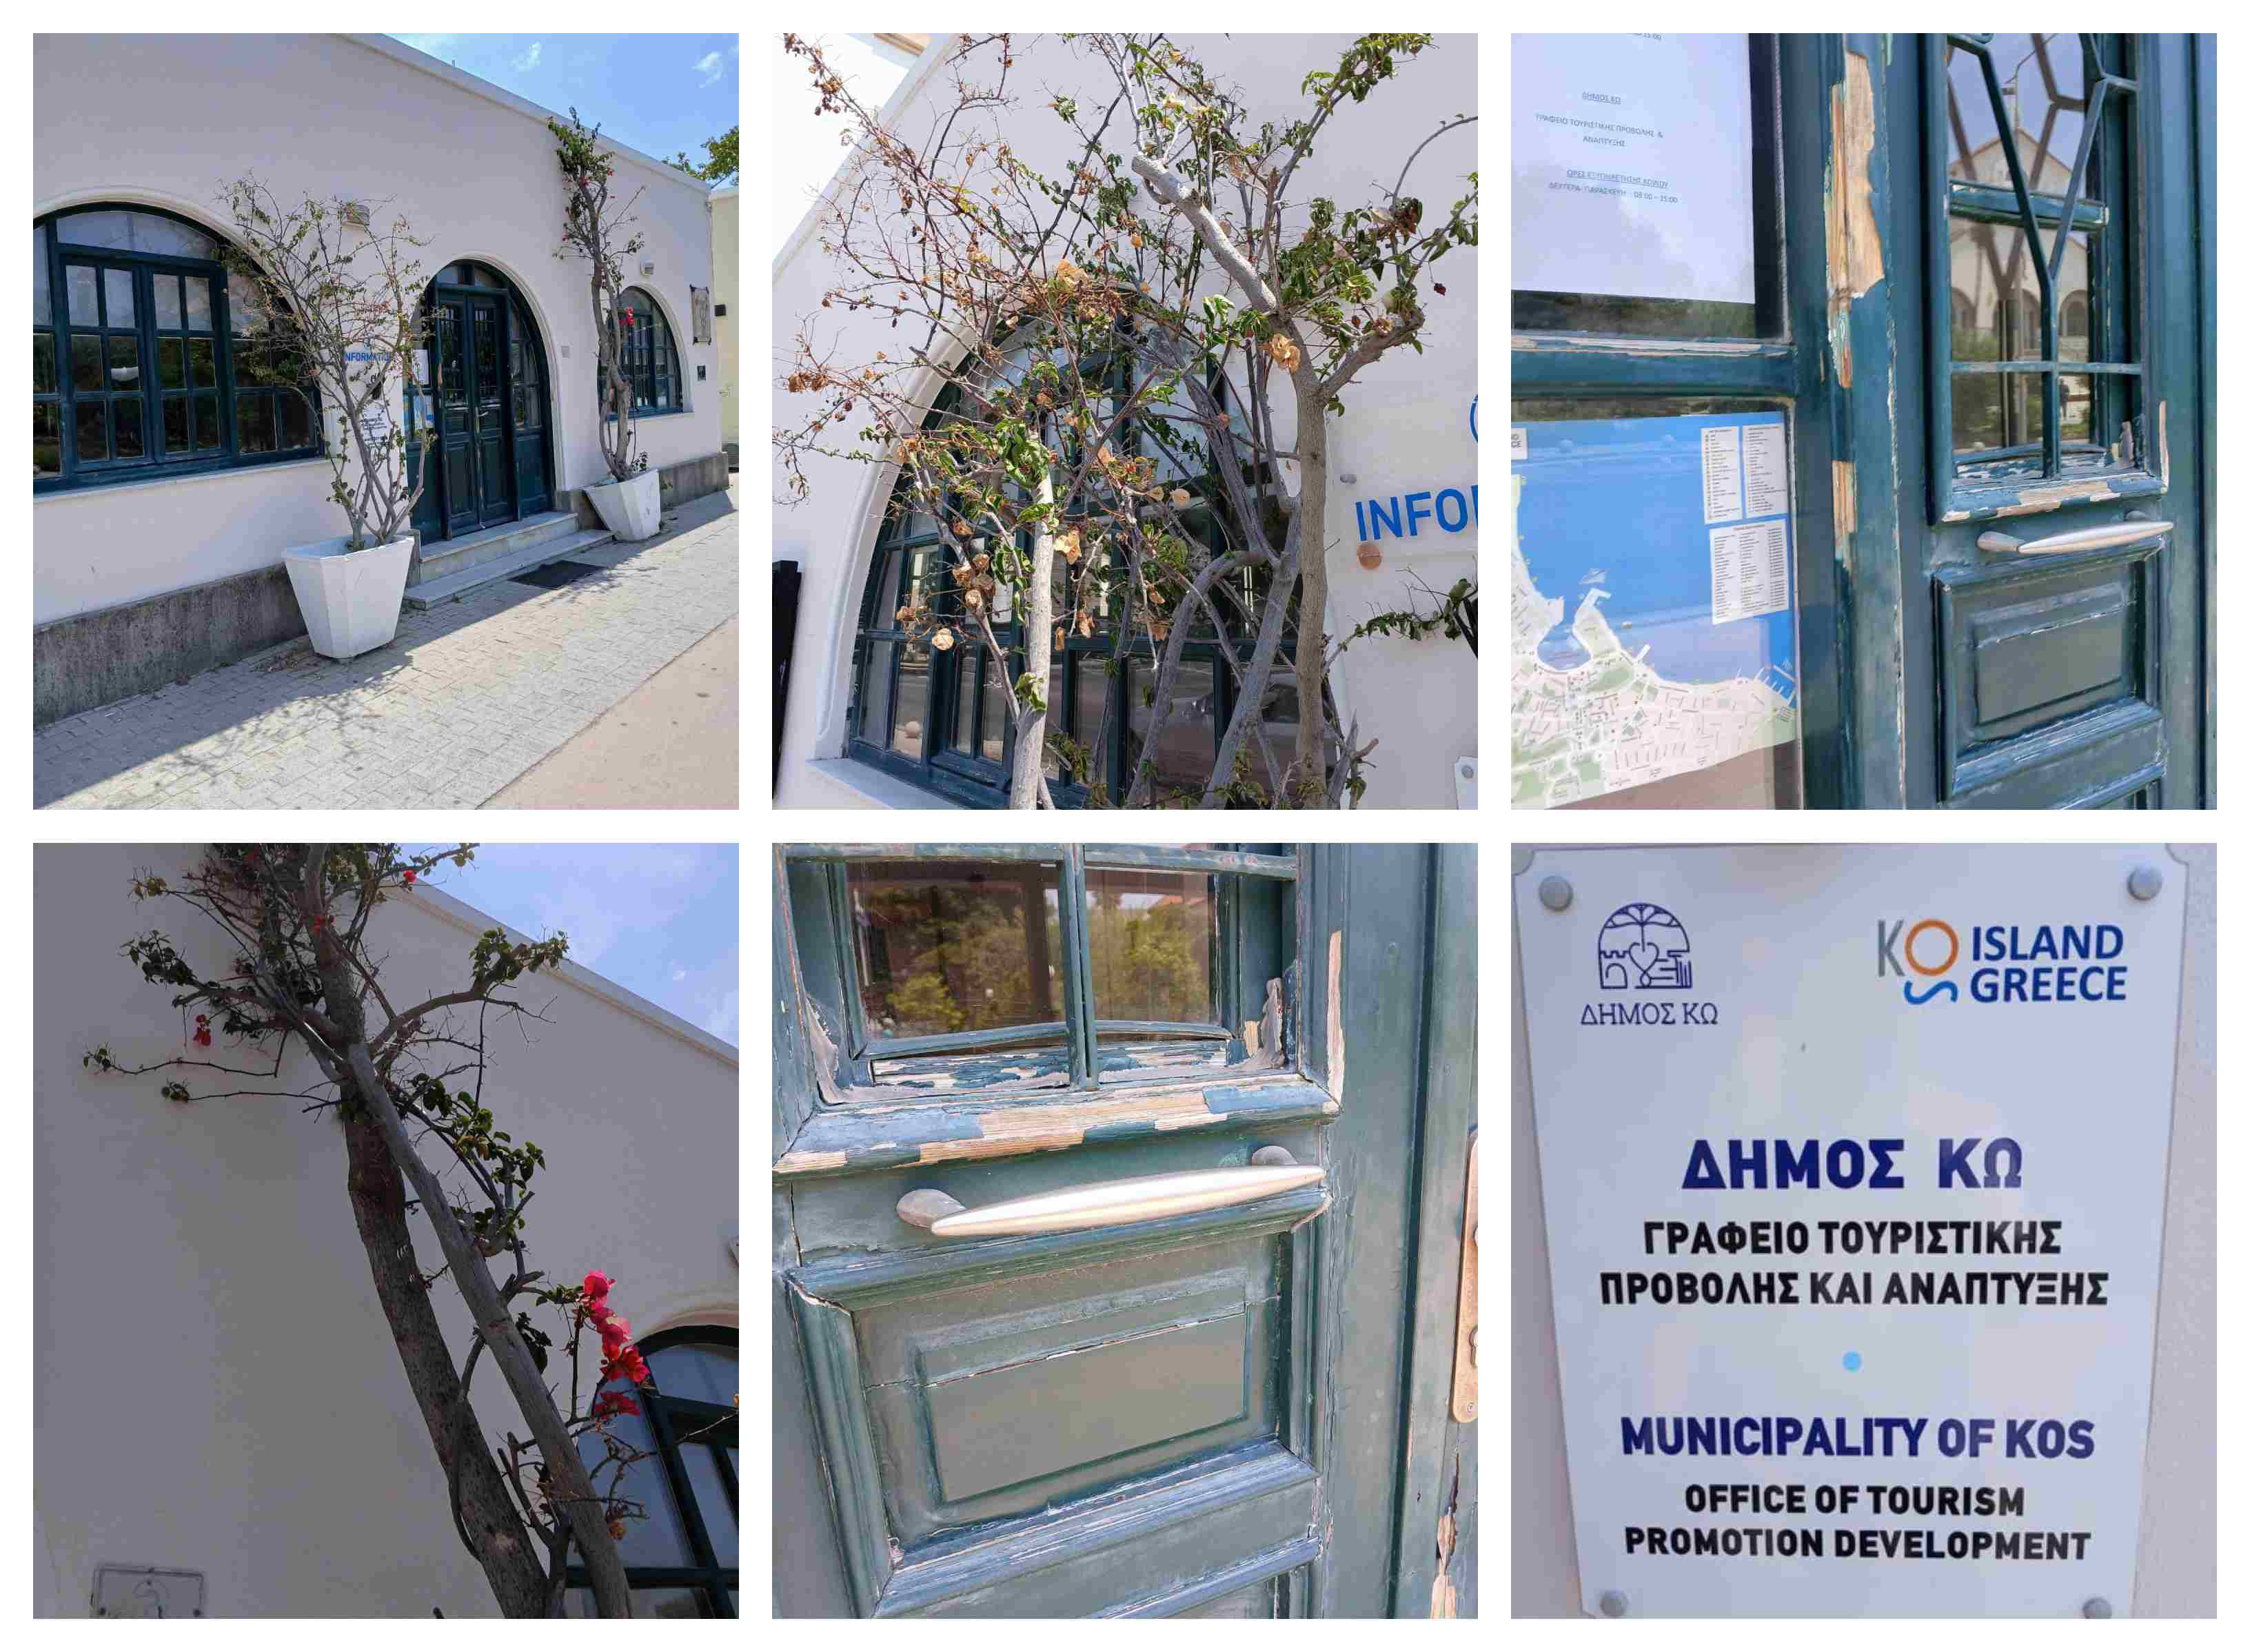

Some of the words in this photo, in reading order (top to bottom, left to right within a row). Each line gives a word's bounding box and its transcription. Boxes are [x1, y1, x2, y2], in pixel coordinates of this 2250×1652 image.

[1355, 485, 1477, 542] INFO
[1973, 925, 2123, 961] ISLAND
[1970, 966, 2127, 1003] GREECE
[1581, 1003, 1675, 1026] ΔΗΜΟΣ
[1682, 1003, 1718, 1026] ΚΩ
[1682, 1139, 1905, 1190] ΔΗΜΟΣ
[1938, 1138, 2022, 1189] ΚΩ
[1644, 1221, 1810, 1254] ΓΡΑΦΕΙΟ
[1818, 1221, 2062, 1254] ΤΟΥΡΙΣΤΙΚΗΣ
[1600, 1272, 1800, 1305] ΠΡΟΒΟΛΗΣ
[1810, 1272, 1872, 1305] ΚΑΙ
[1883, 1272, 2109, 1306] ΑΝΑΠΤΥΞΗΣ
[1621, 1417, 1928, 1457] MUNICIPALITY
[1938, 1418, 1995, 1458] OF
[2006, 1419, 2095, 1459] KOS
[1685, 1484, 1806, 1514] OFFICE
[1815, 1485, 1859, 1514] OF
[1866, 1485, 2024, 1516] TOURISM
[1625, 1527, 1824, 1558] PROMOTION
[1834, 1529, 2091, 1560] DEVELOPMENT
